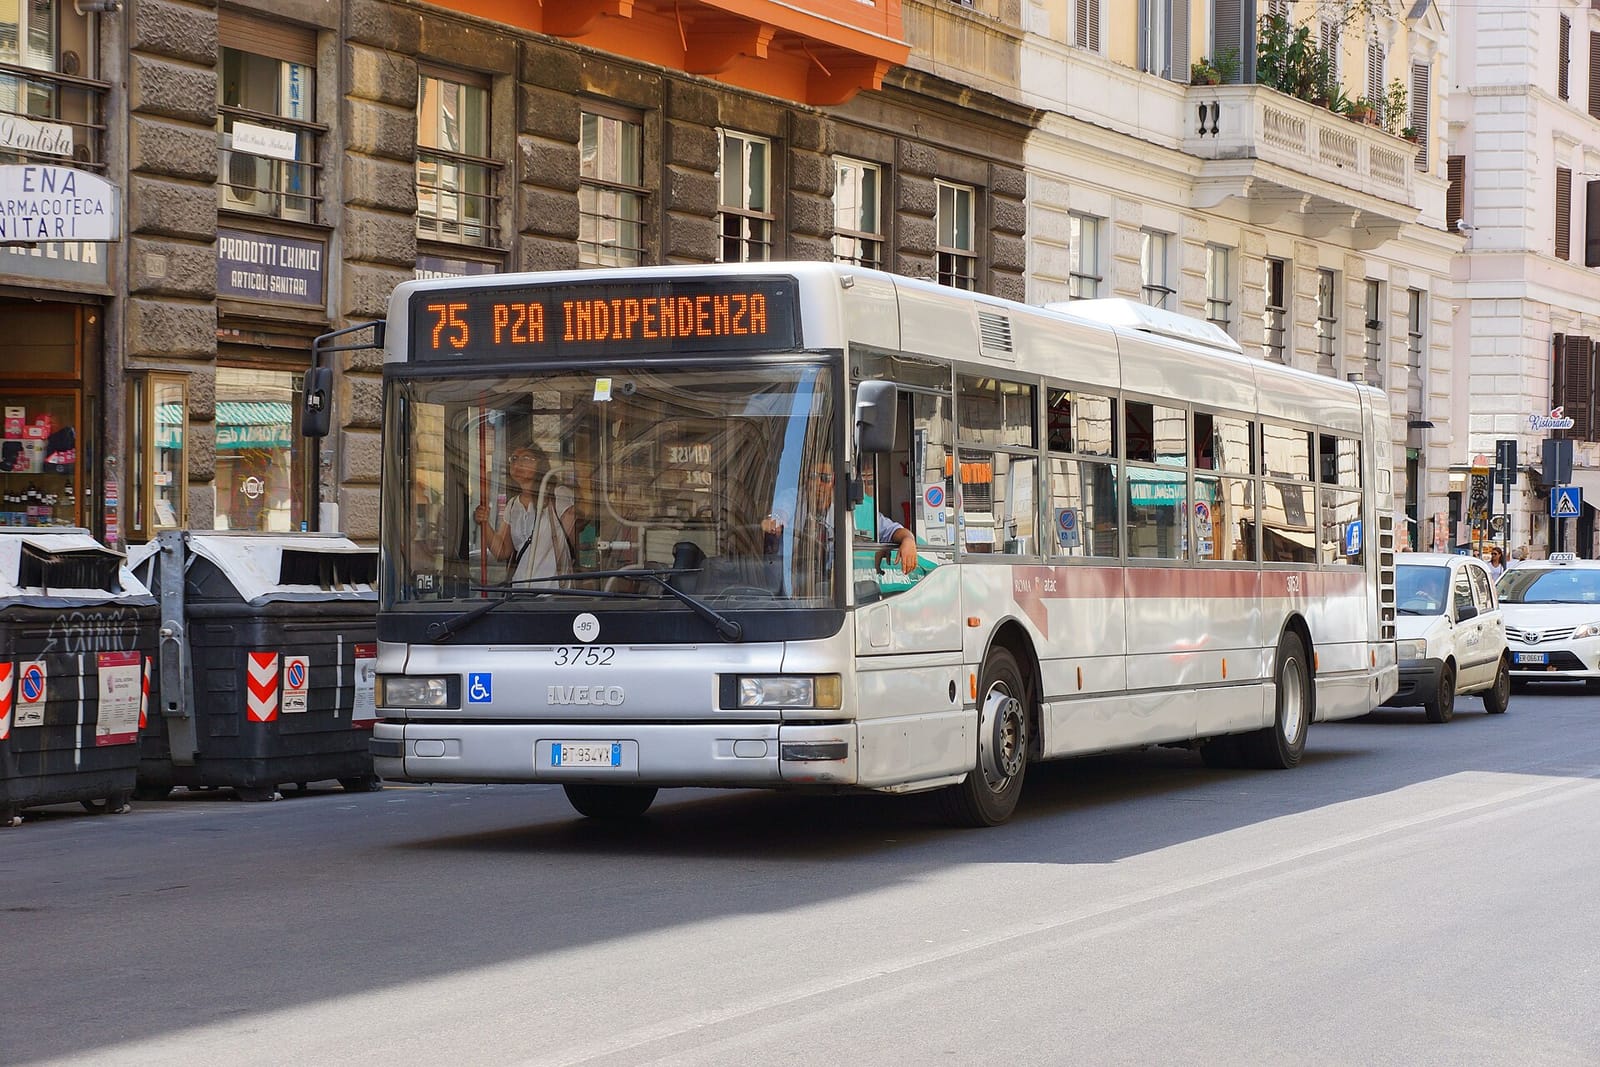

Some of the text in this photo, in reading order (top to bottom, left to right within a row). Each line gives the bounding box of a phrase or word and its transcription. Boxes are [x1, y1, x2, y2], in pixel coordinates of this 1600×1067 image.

[1, 117, 71, 153] Dentista
[23, 167, 76, 196] ENA
[219, 237, 320, 271] PRODOTTI CHIMICI
[231, 270, 307, 296] ARTICOLI SANITARI
[427, 293, 767, 349] 75 PZA INDIPENDENZA
[1529, 414, 1573, 430] Ristorante
[1551, 553, 1573, 561] TAXI
[1044, 577, 1057, 592] atac
[554, 646, 615, 666] 3752
[546, 685, 625, 706] IVECO
